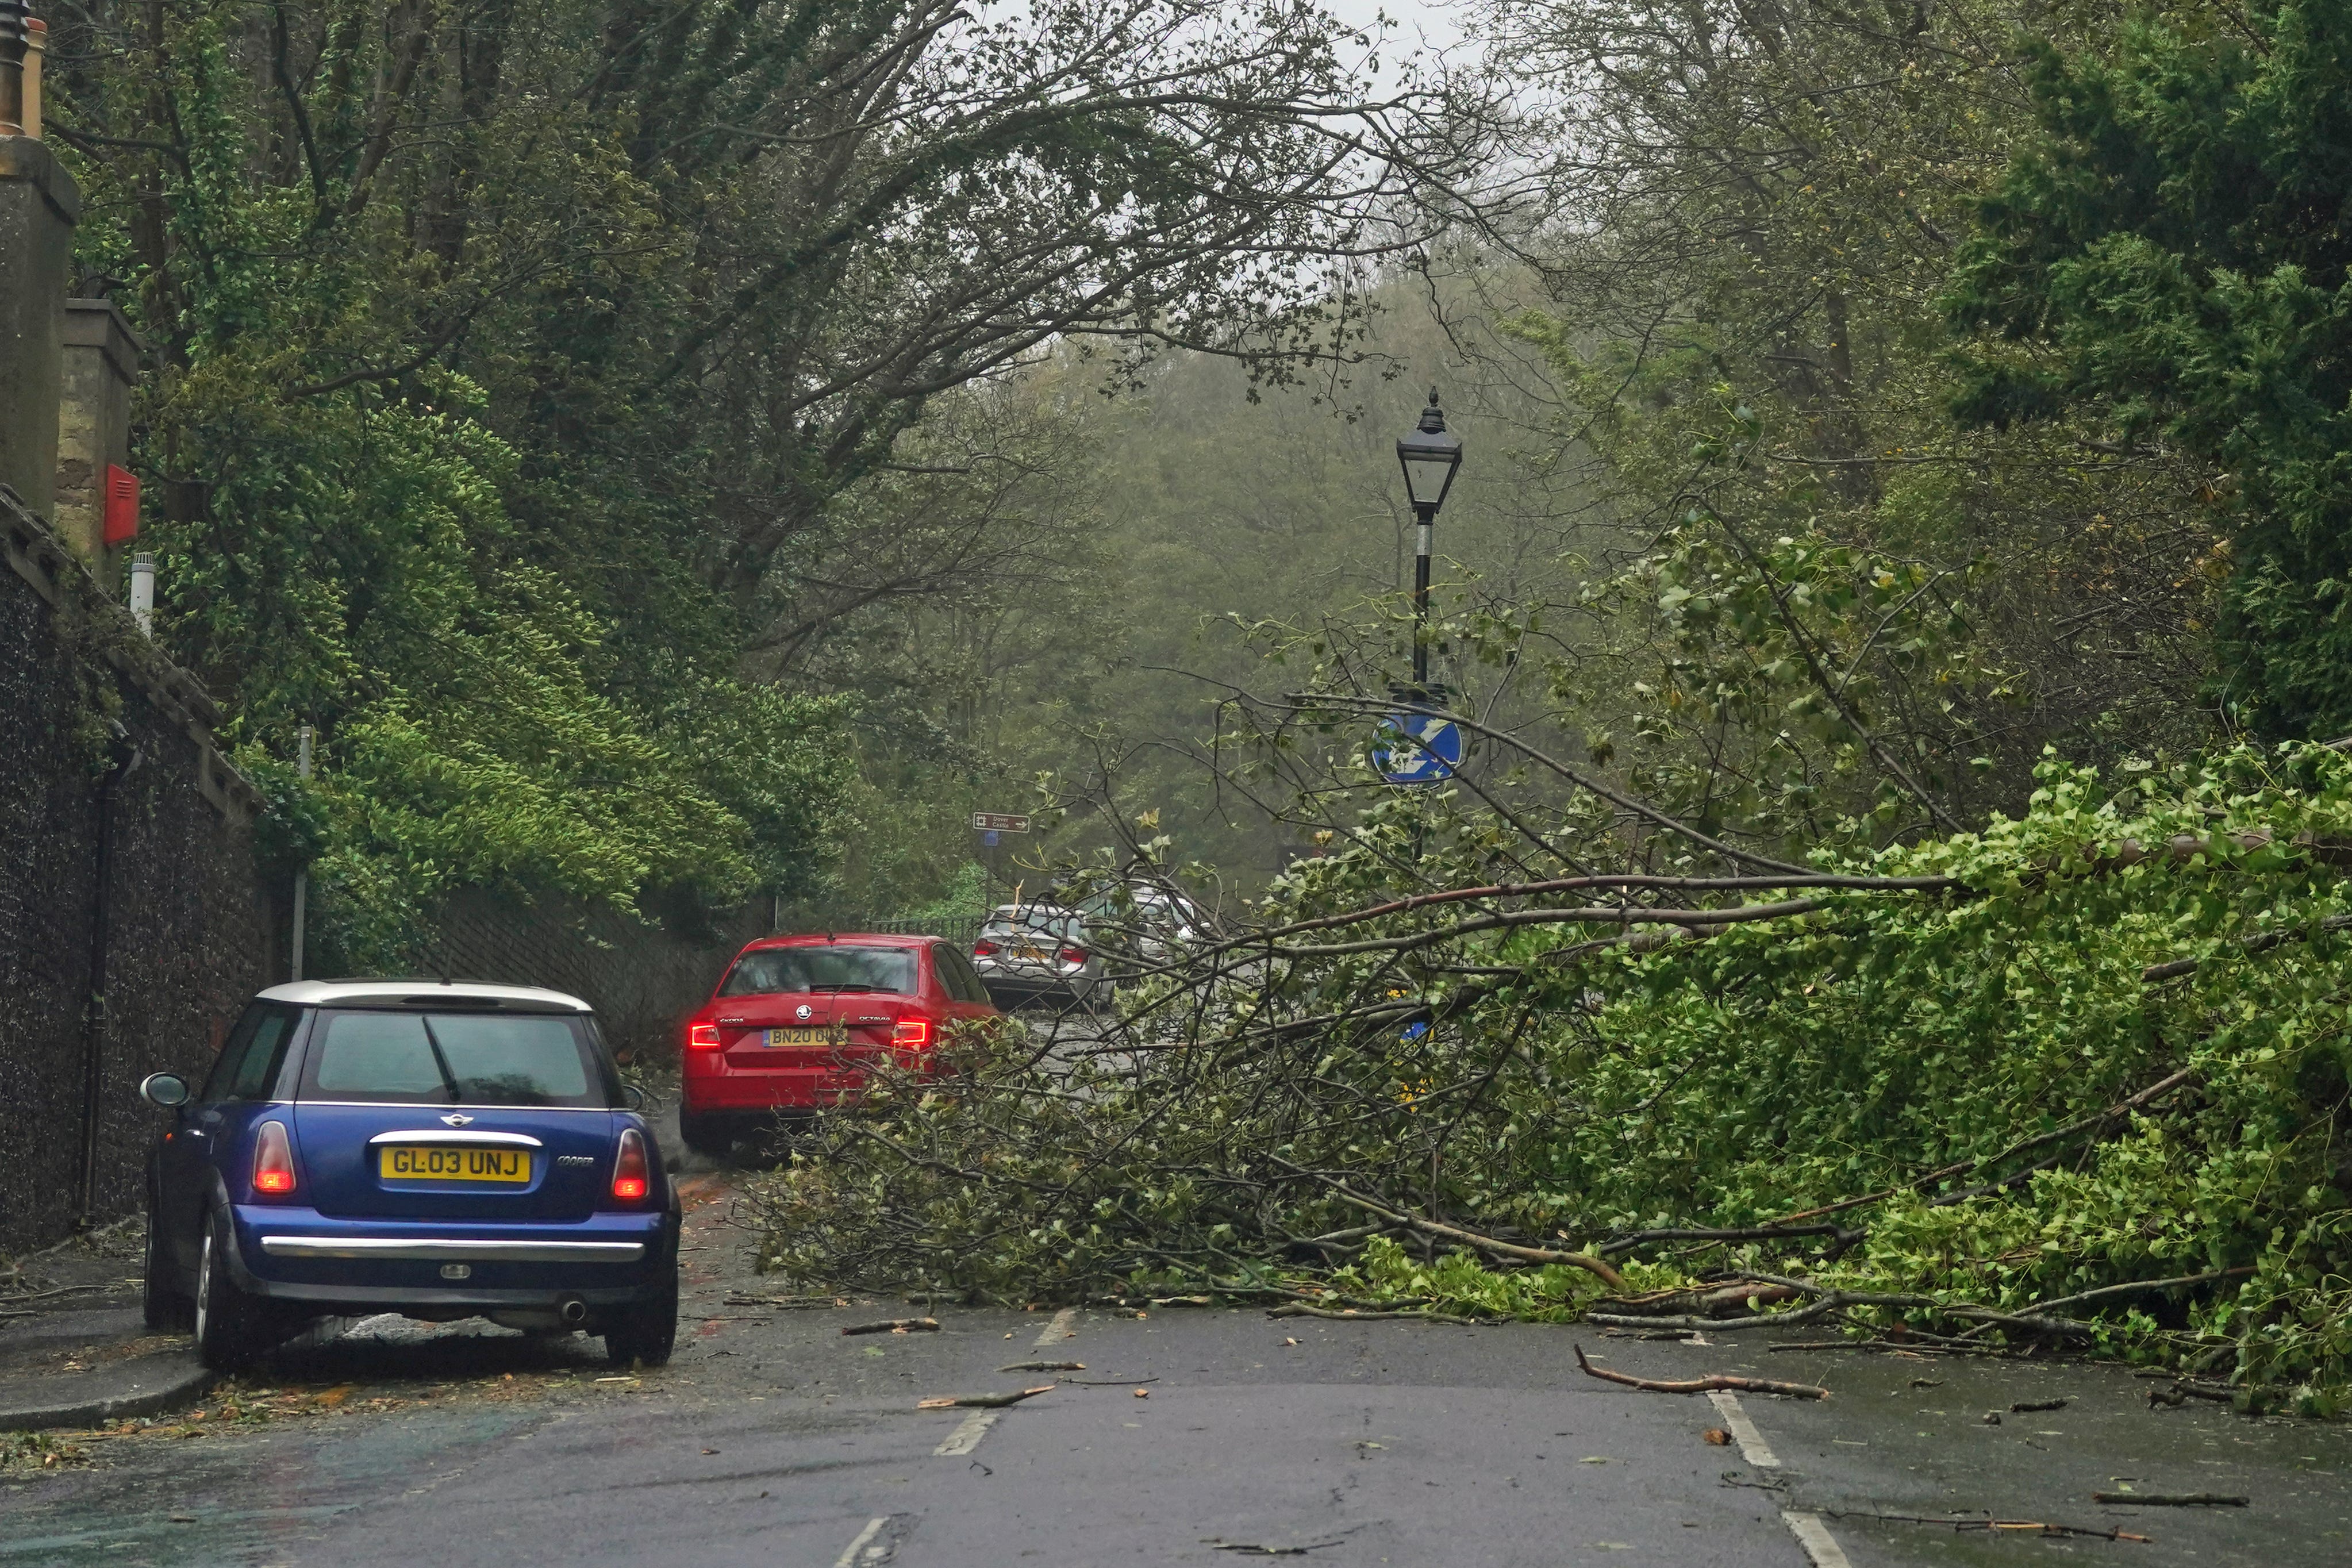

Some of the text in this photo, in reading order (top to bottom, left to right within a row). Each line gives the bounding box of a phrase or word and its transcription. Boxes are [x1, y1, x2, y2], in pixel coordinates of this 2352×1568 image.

[773, 1029, 811, 1043] BN20
[394, 1151, 518, 1176] GL03 UNJ
[556, 1155, 594, 1165] COOPER
